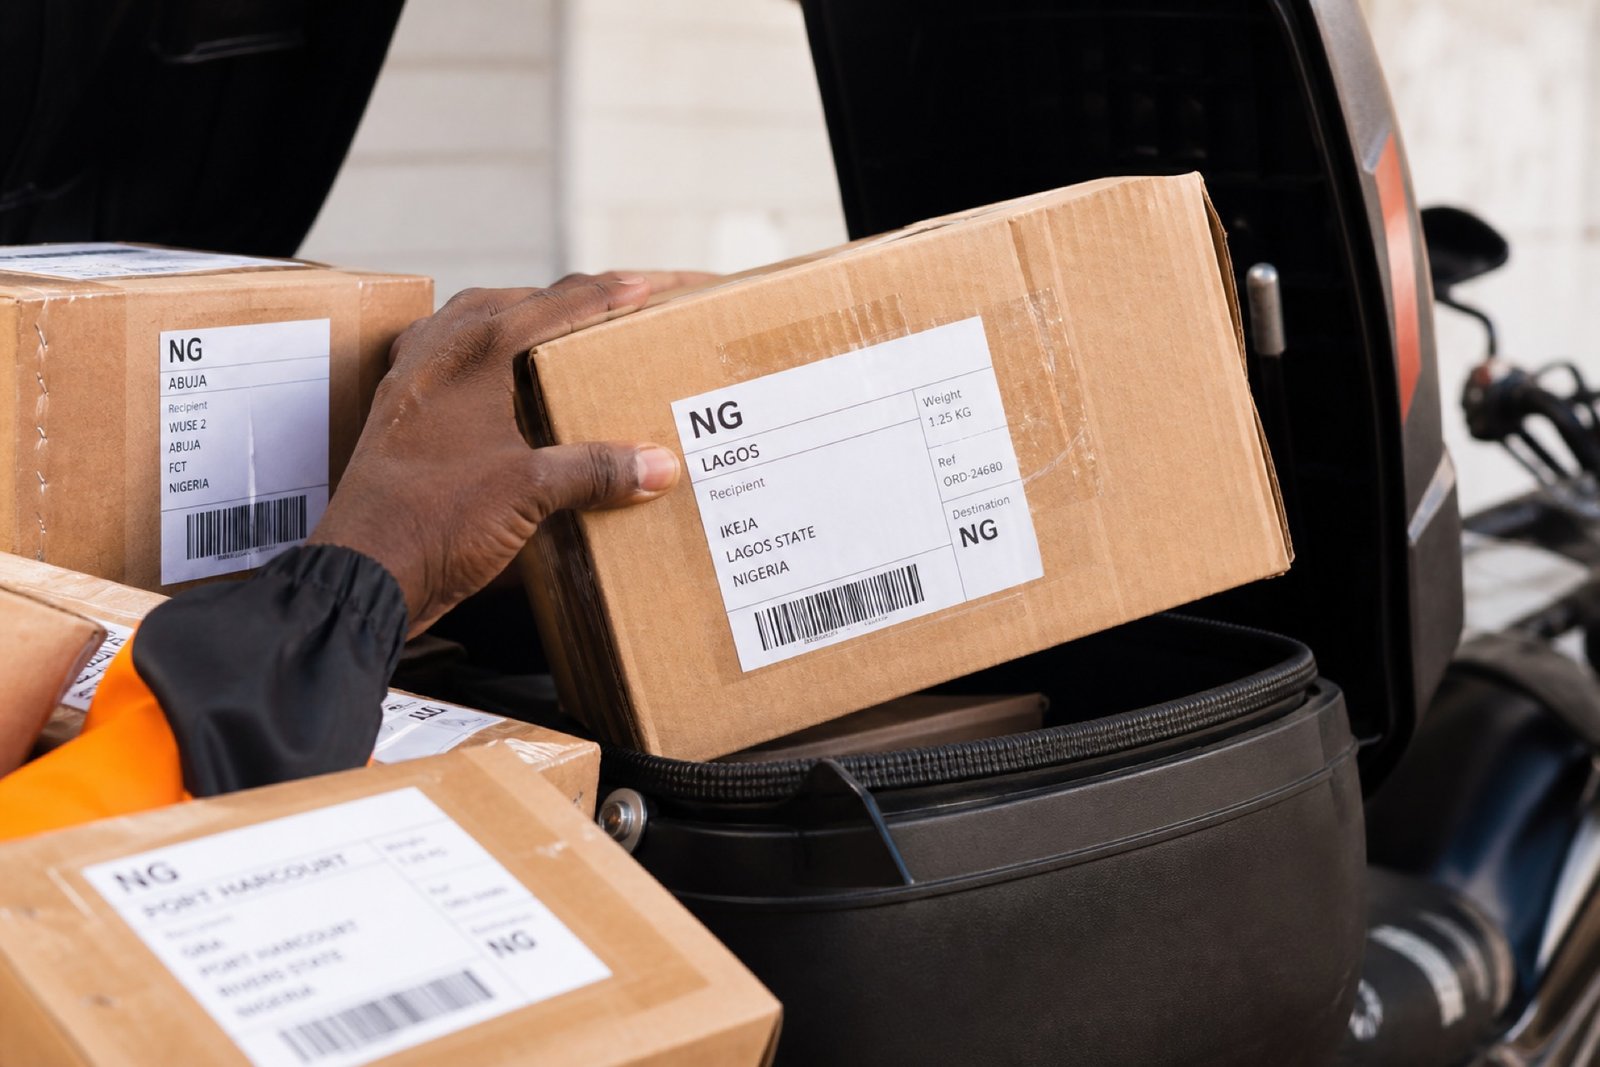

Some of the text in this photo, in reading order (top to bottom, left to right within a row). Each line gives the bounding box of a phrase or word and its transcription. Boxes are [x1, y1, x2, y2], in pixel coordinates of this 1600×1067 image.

[169, 337, 203, 363] NG
[168, 374, 207, 390] ABUJA
[168, 400, 208, 415] Recipient
[922, 389, 963, 408] Weight
[169, 418, 207, 434] WUSE 2
[689, 400, 743, 439] NG
[928, 406, 972, 428] 1.25 KG
[168, 439, 201, 454] ABUJA
[701, 443, 760, 473] LAGOS
[169, 460, 187, 474] FCT
[937, 453, 957, 468] Ref
[169, 477, 210, 494] NIGERIA
[943, 461, 1003, 487] ORD-24680
[709, 477, 766, 501] Recipient
[952, 496, 1011, 520] Destination
[720, 517, 759, 539] IKEJA
[958, 518, 999, 548] NG
[726, 525, 816, 563] LAGOS STATE
[732, 560, 790, 588] NIGERIA
[113, 860, 180, 893] NG
[142, 852, 348, 918] PORT HARCOURT
[487, 930, 536, 959] NG
